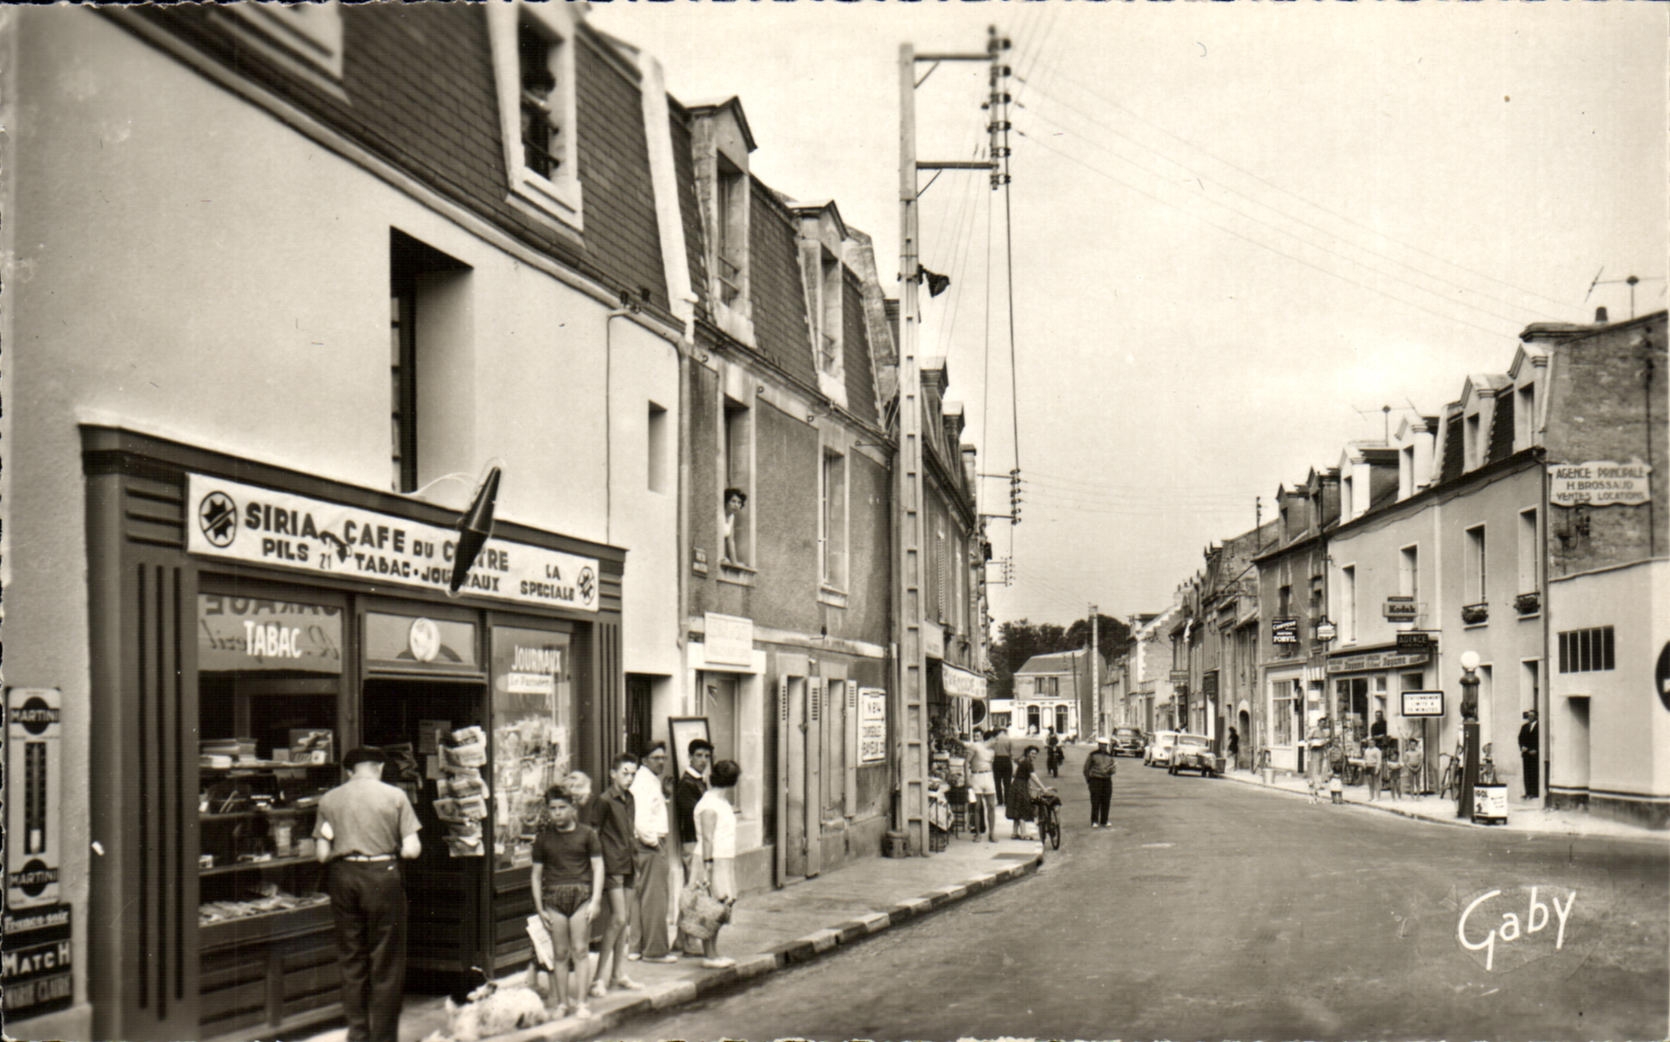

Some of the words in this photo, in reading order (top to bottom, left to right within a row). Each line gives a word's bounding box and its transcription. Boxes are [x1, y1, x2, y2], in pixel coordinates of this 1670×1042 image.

[1556, 467, 1592, 479] AGENCE
[1597, 467, 1644, 479] PRINCIPALE
[1556, 491, 1592, 501] VENTES
[1597, 491, 1645, 501] LOCATIONS
[244, 501, 319, 540] SIRIA
[262, 537, 309, 562] PILS
[343, 519, 406, 554] CAFE
[413, 540, 434, 558] DU
[442, 540, 510, 572] CTRE
[354, 552, 411, 578] TABAC
[421, 566, 501, 592] JOUAUX
[545, 564, 561, 581] LA
[519, 580, 575, 602] SPECIALE
[1388, 604, 1417, 614] Kodak
[243, 619, 302, 658] TABAC
[9, 708, 60, 723] MARTINI
[9, 869, 58, 887] MARTINI
